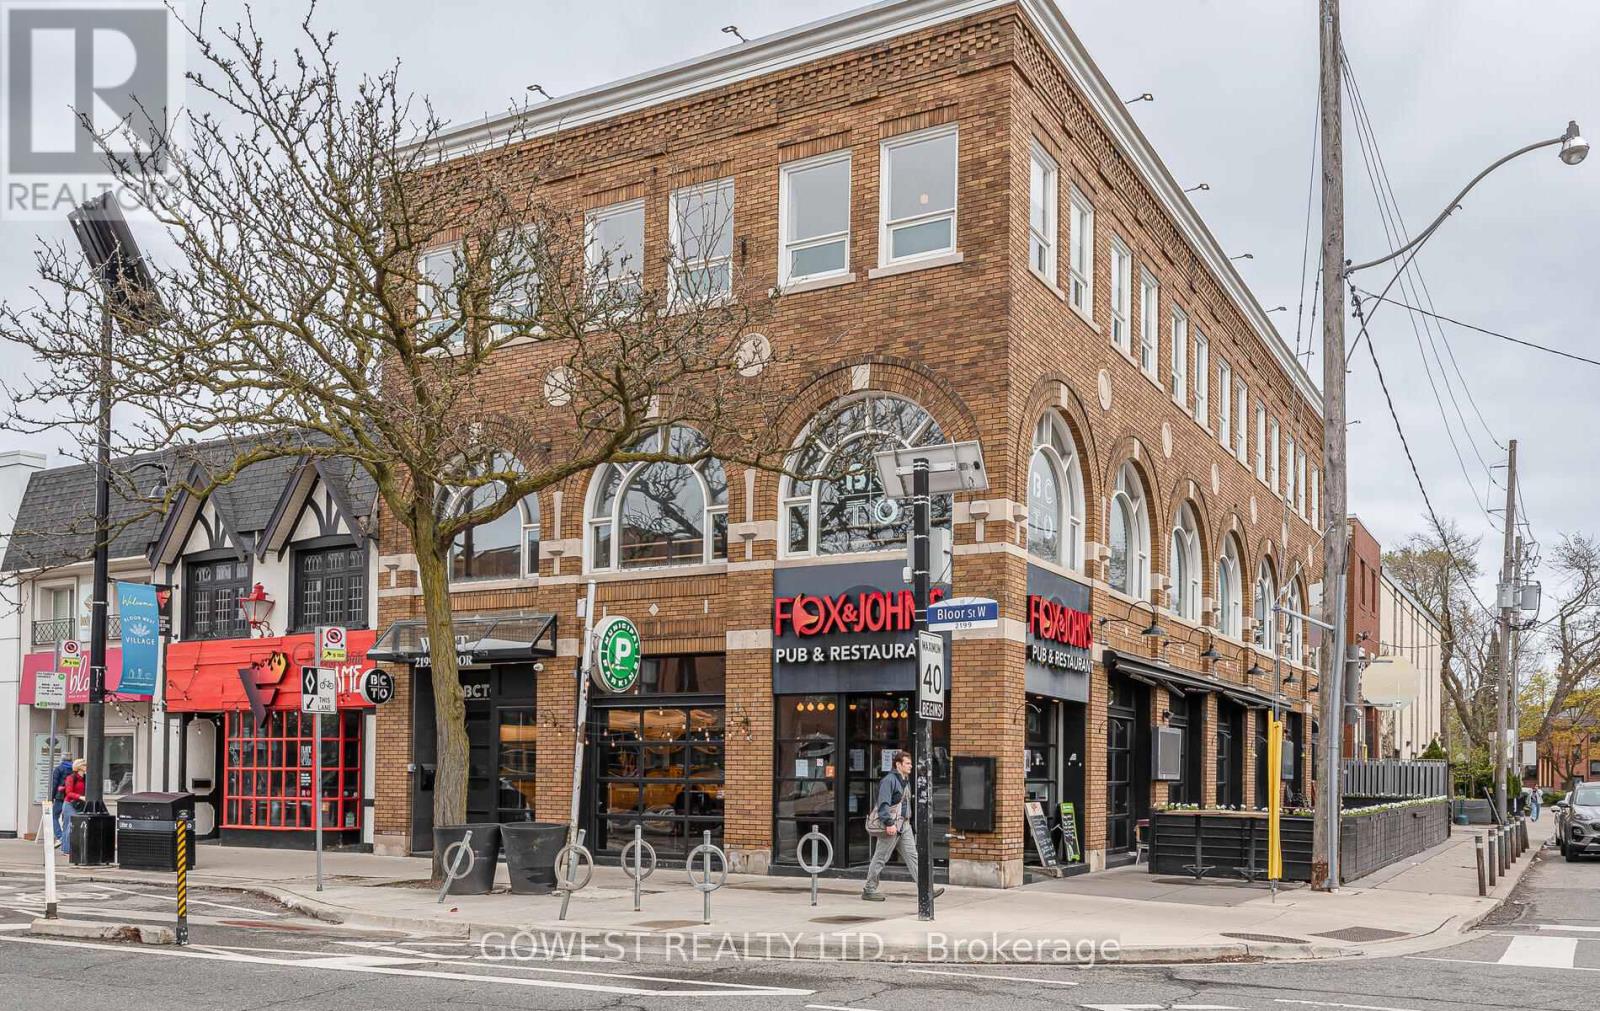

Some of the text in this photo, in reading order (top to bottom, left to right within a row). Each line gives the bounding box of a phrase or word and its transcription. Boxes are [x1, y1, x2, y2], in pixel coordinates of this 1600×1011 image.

[937, 605, 986, 620] Bloor St W
[125, 636, 156, 646] VILLAGE
[604, 622, 639, 649] MUNICIPAL
[615, 637, 632, 665] P
[776, 643, 917, 663] PUB & RESTAURA
[1032, 645, 1095, 673] PUB & RESTAURANT
[370, 674, 388, 686] BC
[603, 659, 639, 687] PARKING
[922, 663, 942, 695] 40
[370, 687, 388, 699] TO
[463, 684, 492, 698] BCT
[319, 696, 331, 704] THIS
[922, 702, 943, 717] BEGINS
